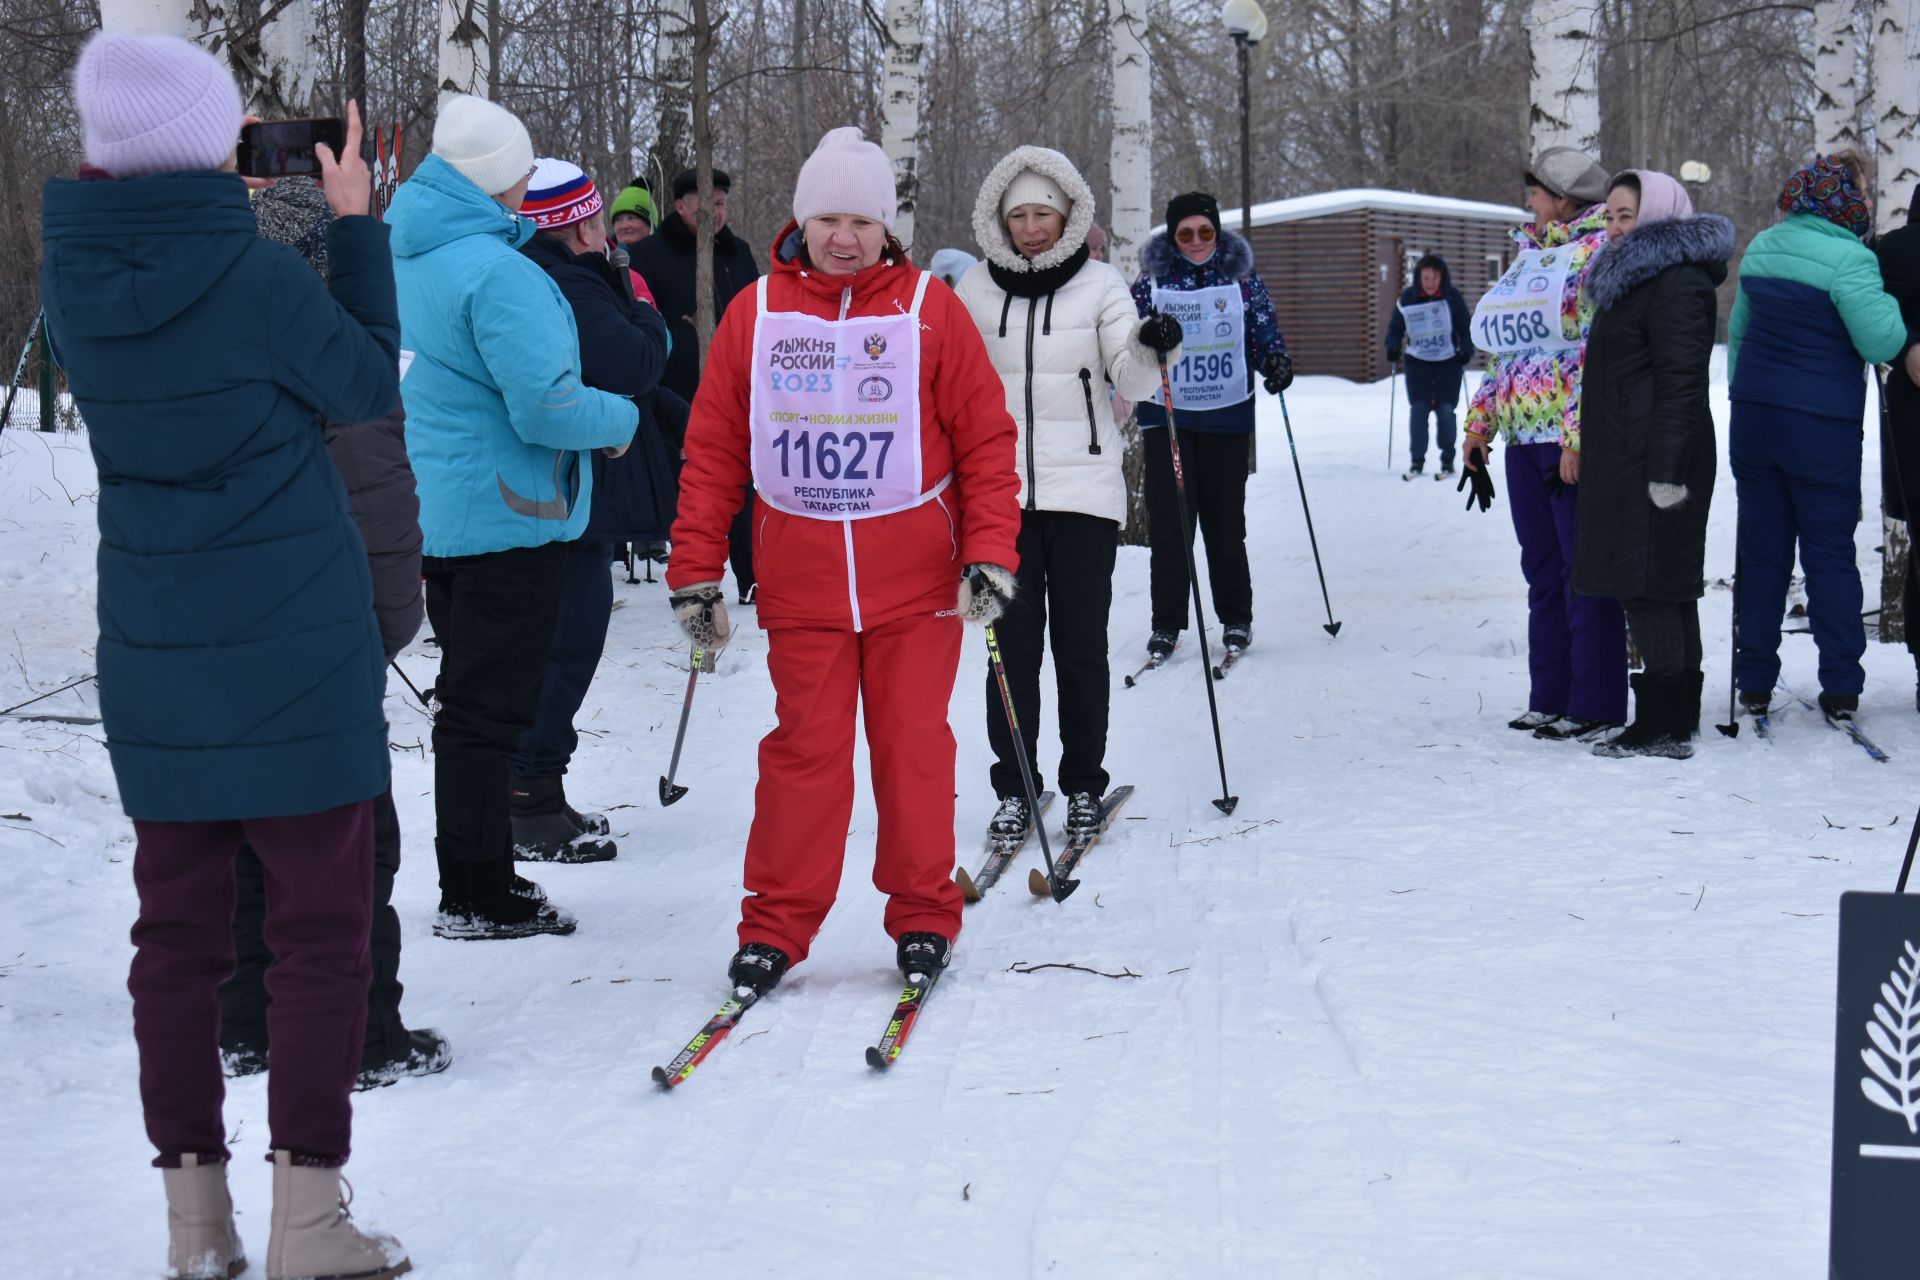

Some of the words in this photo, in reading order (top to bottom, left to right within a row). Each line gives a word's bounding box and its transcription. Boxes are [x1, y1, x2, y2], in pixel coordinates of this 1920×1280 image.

[1163, 303, 1201, 313] ЛЫЖНЯ
[1480, 310, 1550, 346] 11568
[770, 337, 836, 354] ЛЫЖНЯ
[769, 353, 835, 370] РОССИИ
[1172, 352, 1233, 382] 11596
[771, 371, 833, 393] 2023
[1179, 384, 1224, 394] РЕСПУБЛИКА
[809, 414, 853, 425] НОРМА
[854, 414, 898, 424] ЖИЗНИ
[772, 429, 895, 480] 11627
[793, 486, 876, 499] РЕСПУБЛИКА
[801, 500, 871, 512] ТАТАРСТАН
